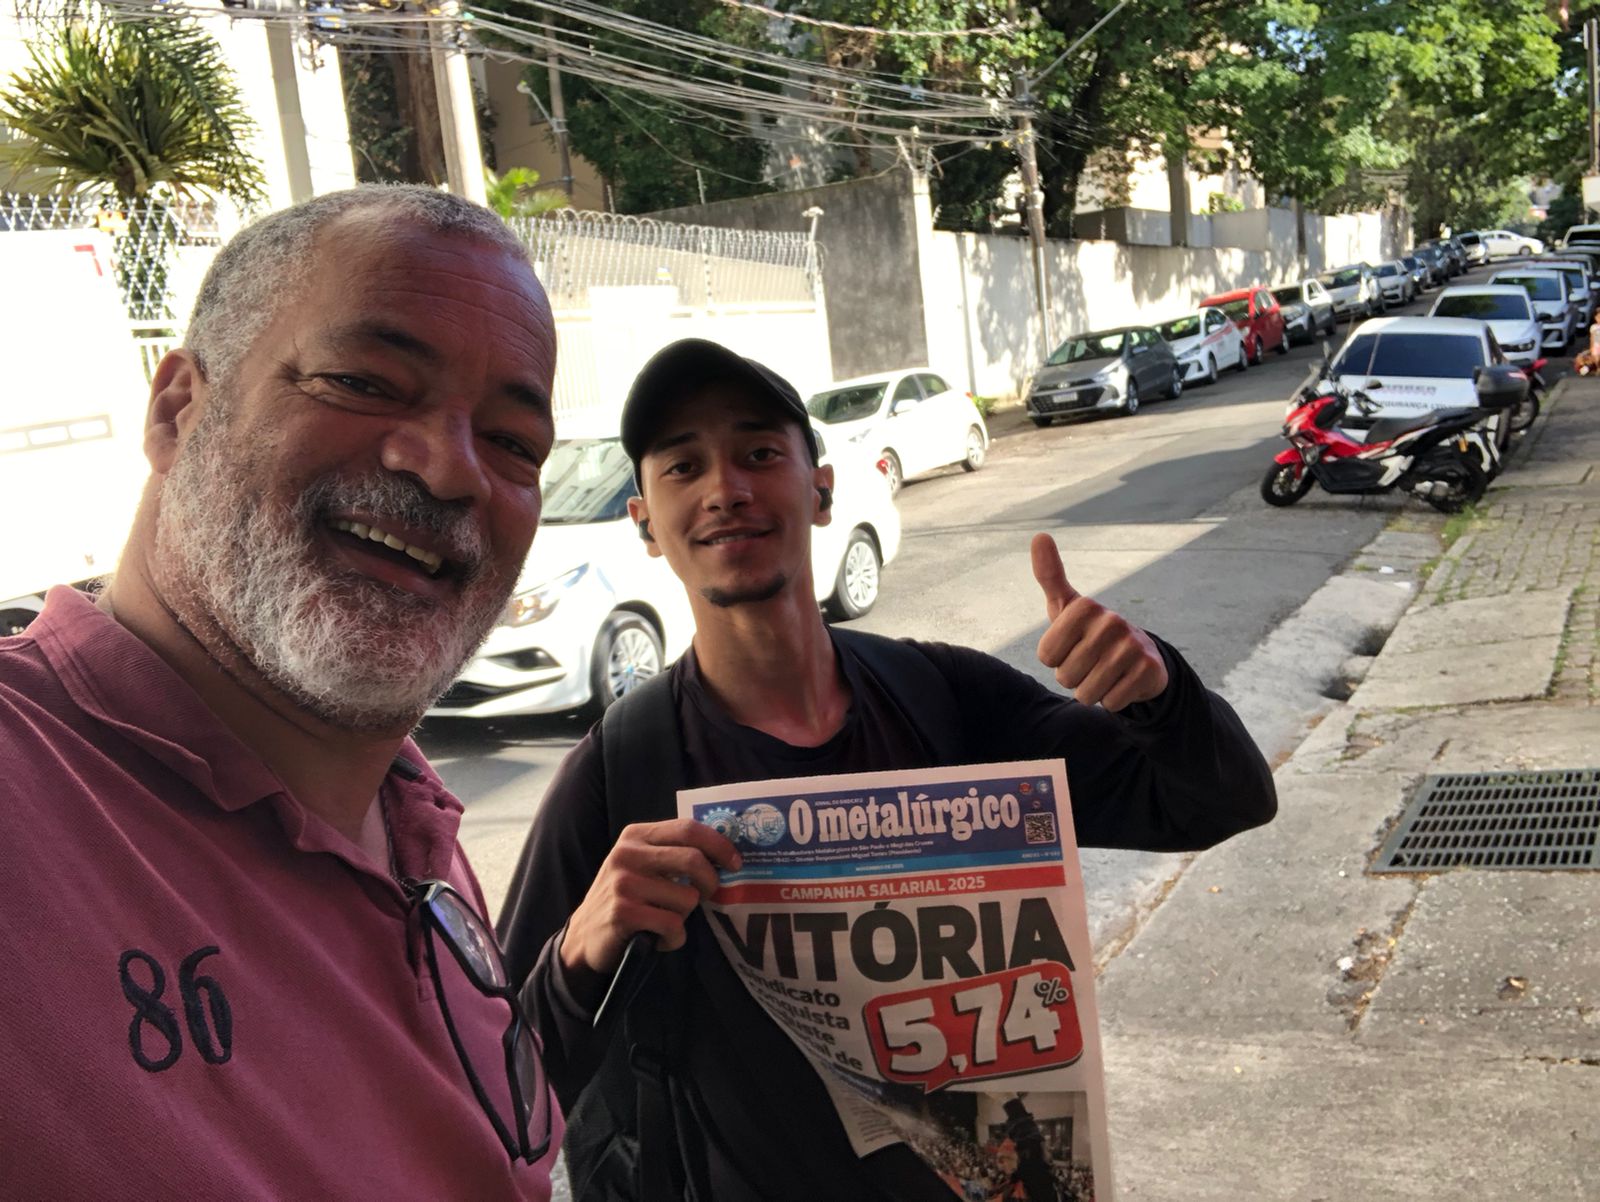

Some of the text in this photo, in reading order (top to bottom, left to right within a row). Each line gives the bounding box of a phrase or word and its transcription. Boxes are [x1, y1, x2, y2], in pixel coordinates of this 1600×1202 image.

[789, 787, 1020, 845] O metalúrgico
[780, 875, 986, 900] CAMPANHA SALARIAL 2025
[712, 897, 1075, 983] VITÓRIA
[119, 946, 232, 1072] 86
[834, 1051, 863, 1071] de
